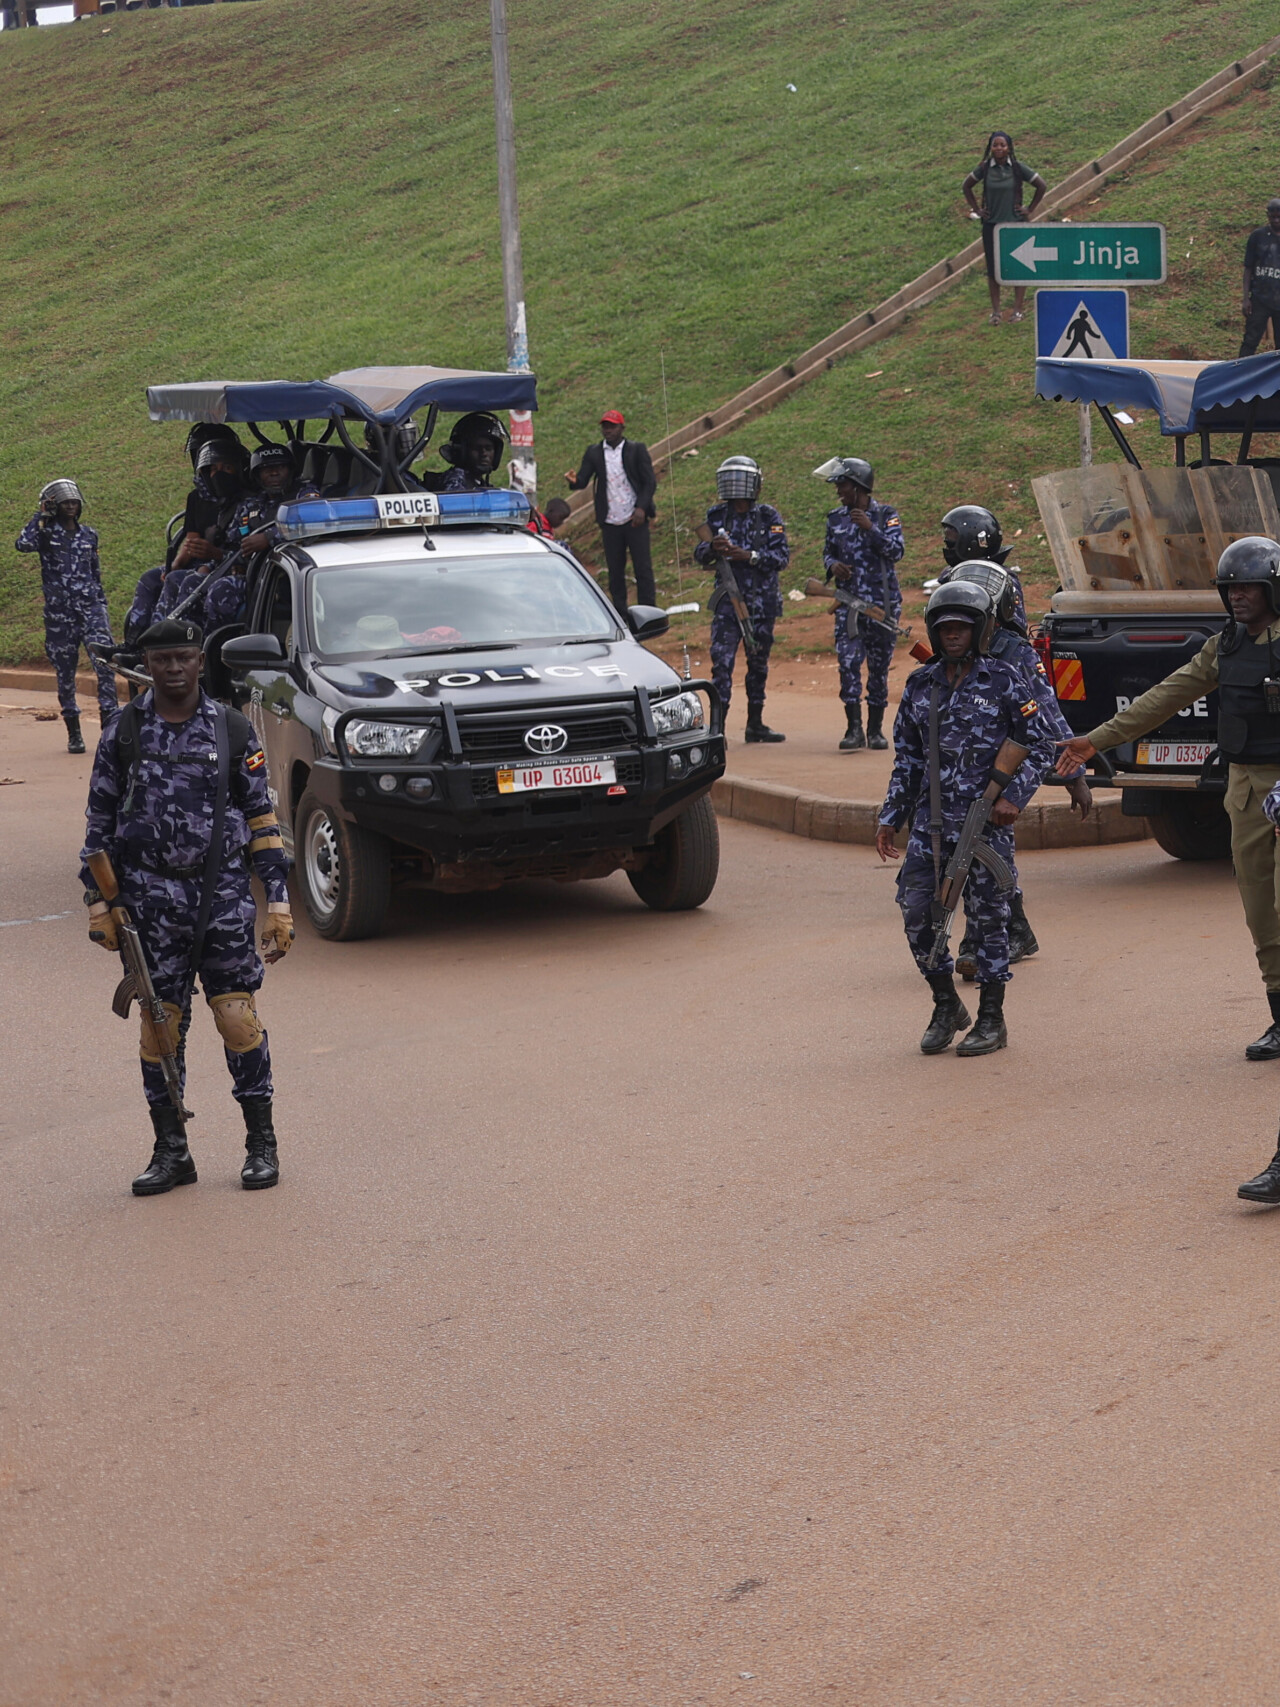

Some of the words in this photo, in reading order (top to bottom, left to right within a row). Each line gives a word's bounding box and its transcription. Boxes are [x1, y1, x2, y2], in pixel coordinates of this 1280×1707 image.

[1073, 241, 1139, 269] Jinja
[260, 449, 283, 457] POLICE
[385, 499, 432, 515] POLICE
[394, 664, 628, 693] POLICE
[974, 698, 988, 706] FFU
[1116, 696, 1209, 717] PCE
[1155, 746, 1170, 762] UP
[1176, 746, 1210, 762] 03348
[523, 770, 543, 788] UP
[553, 765, 602, 786] 03004
